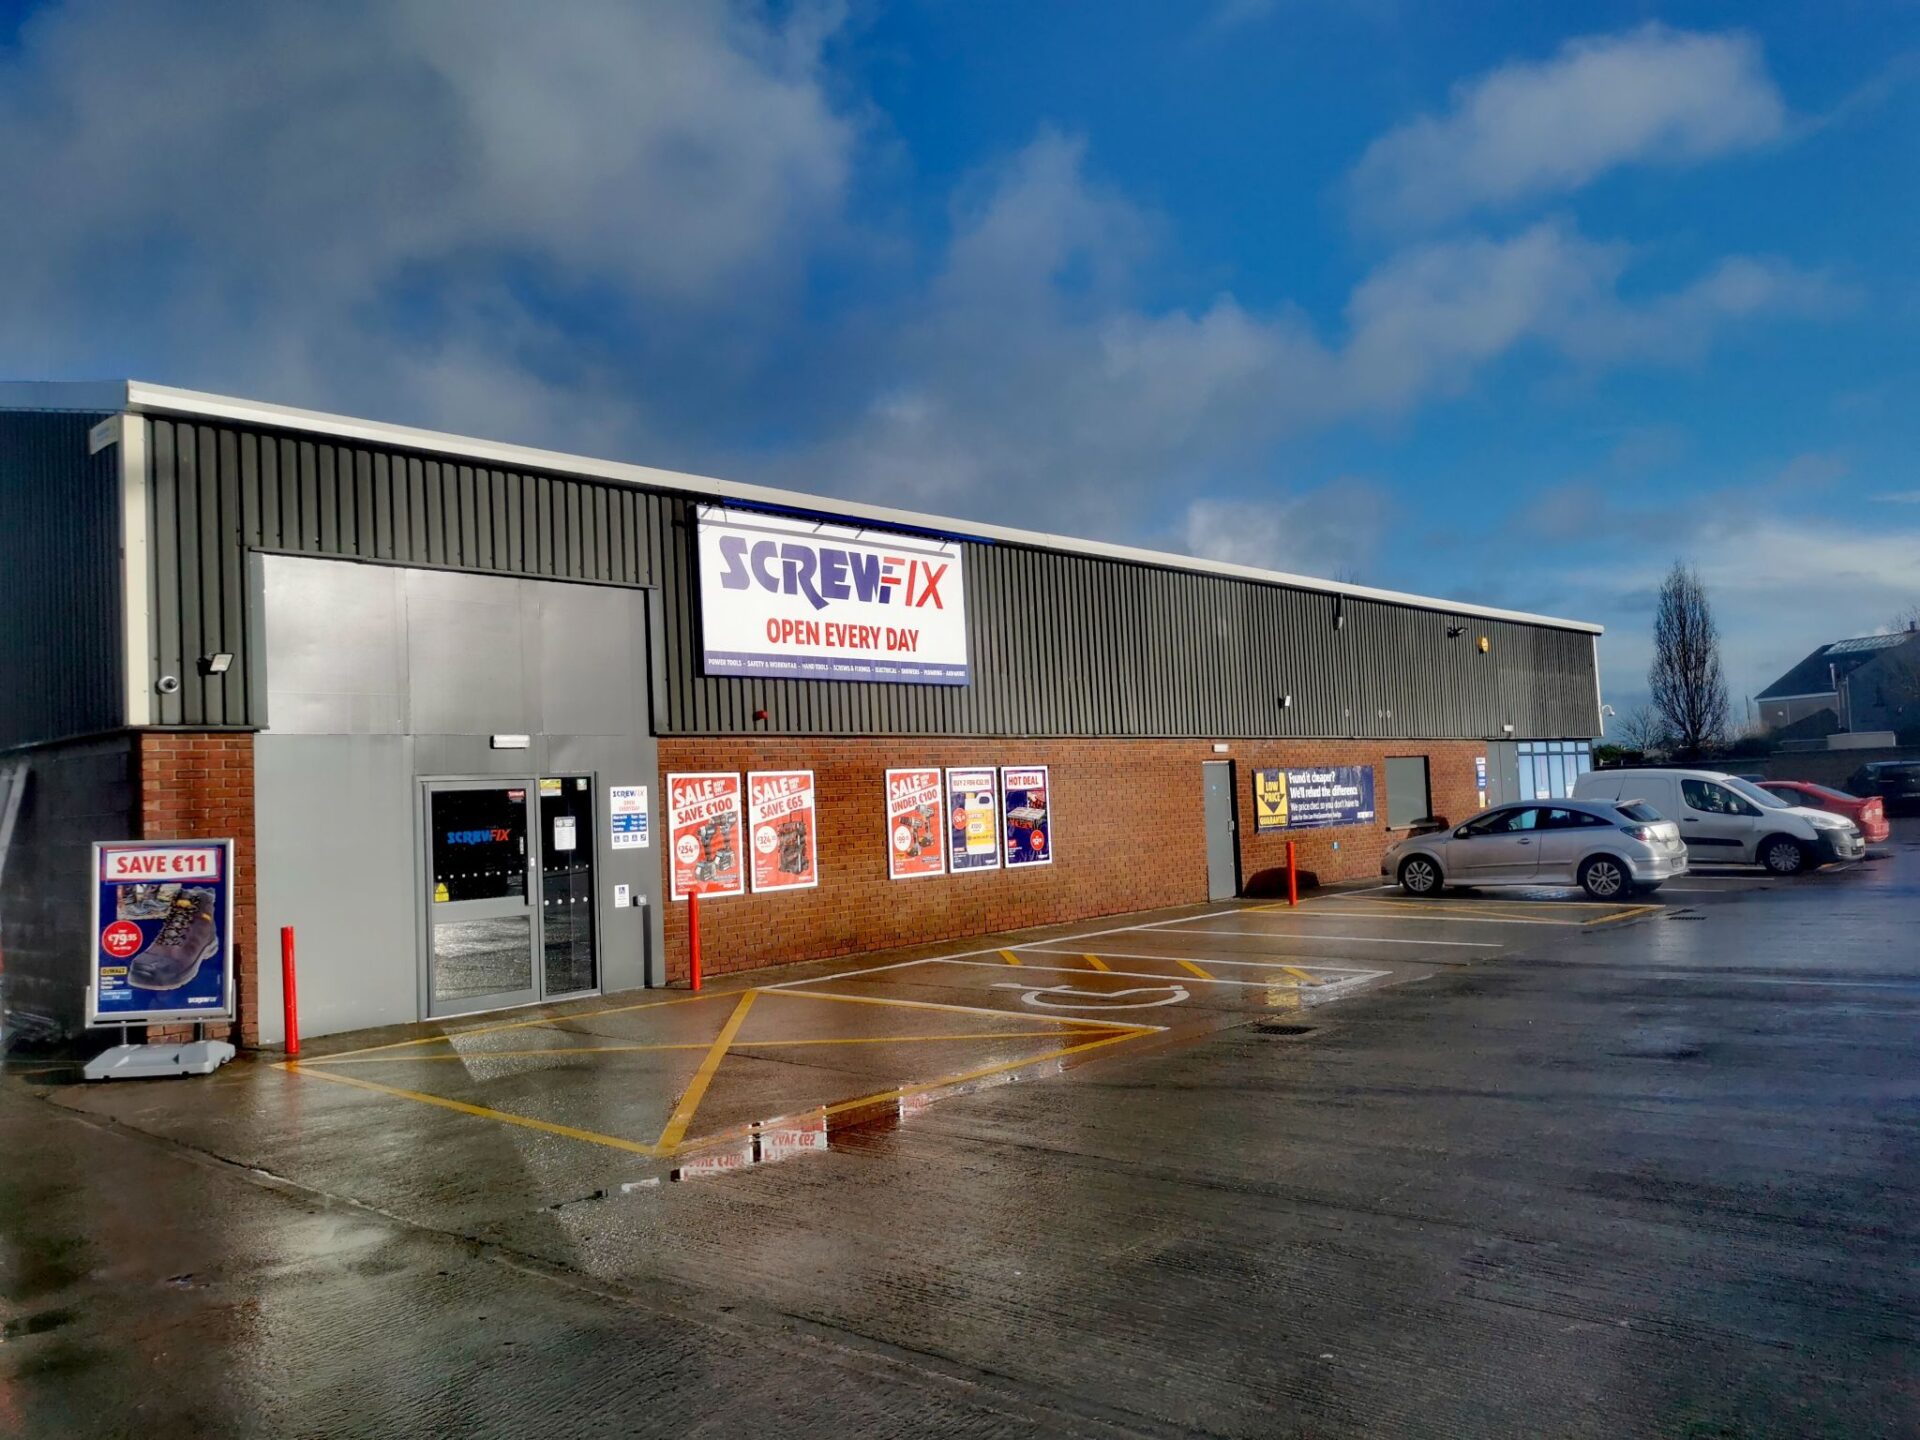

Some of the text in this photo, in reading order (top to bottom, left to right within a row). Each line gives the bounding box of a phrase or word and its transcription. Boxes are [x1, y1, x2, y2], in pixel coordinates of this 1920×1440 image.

[719, 535, 948, 610] SCREWFIX
[766, 618, 919, 652] OPEN EVERY DAY
[708, 658, 742, 667] POWER TOOLS
[891, 774, 921, 799] SALE
[1008, 775, 1039, 786] HOT DEAL
[1265, 781, 1279, 792] LOW
[1288, 772, 1306, 784] Found
[1311, 770, 1336, 784] cheaper?
[674, 779, 714, 809] SALE
[753, 777, 791, 805] SALE
[891, 789, 938, 812] UNDER €100
[1264, 792, 1281, 802] PRICE
[1289, 786, 1305, 799] We'll
[1321, 786, 1331, 797] the
[677, 797, 733, 825] SAVE €100
[760, 795, 804, 819] SAVE €65
[447, 828, 512, 845] SCREWFIX
[117, 854, 206, 874] SAVE €11
